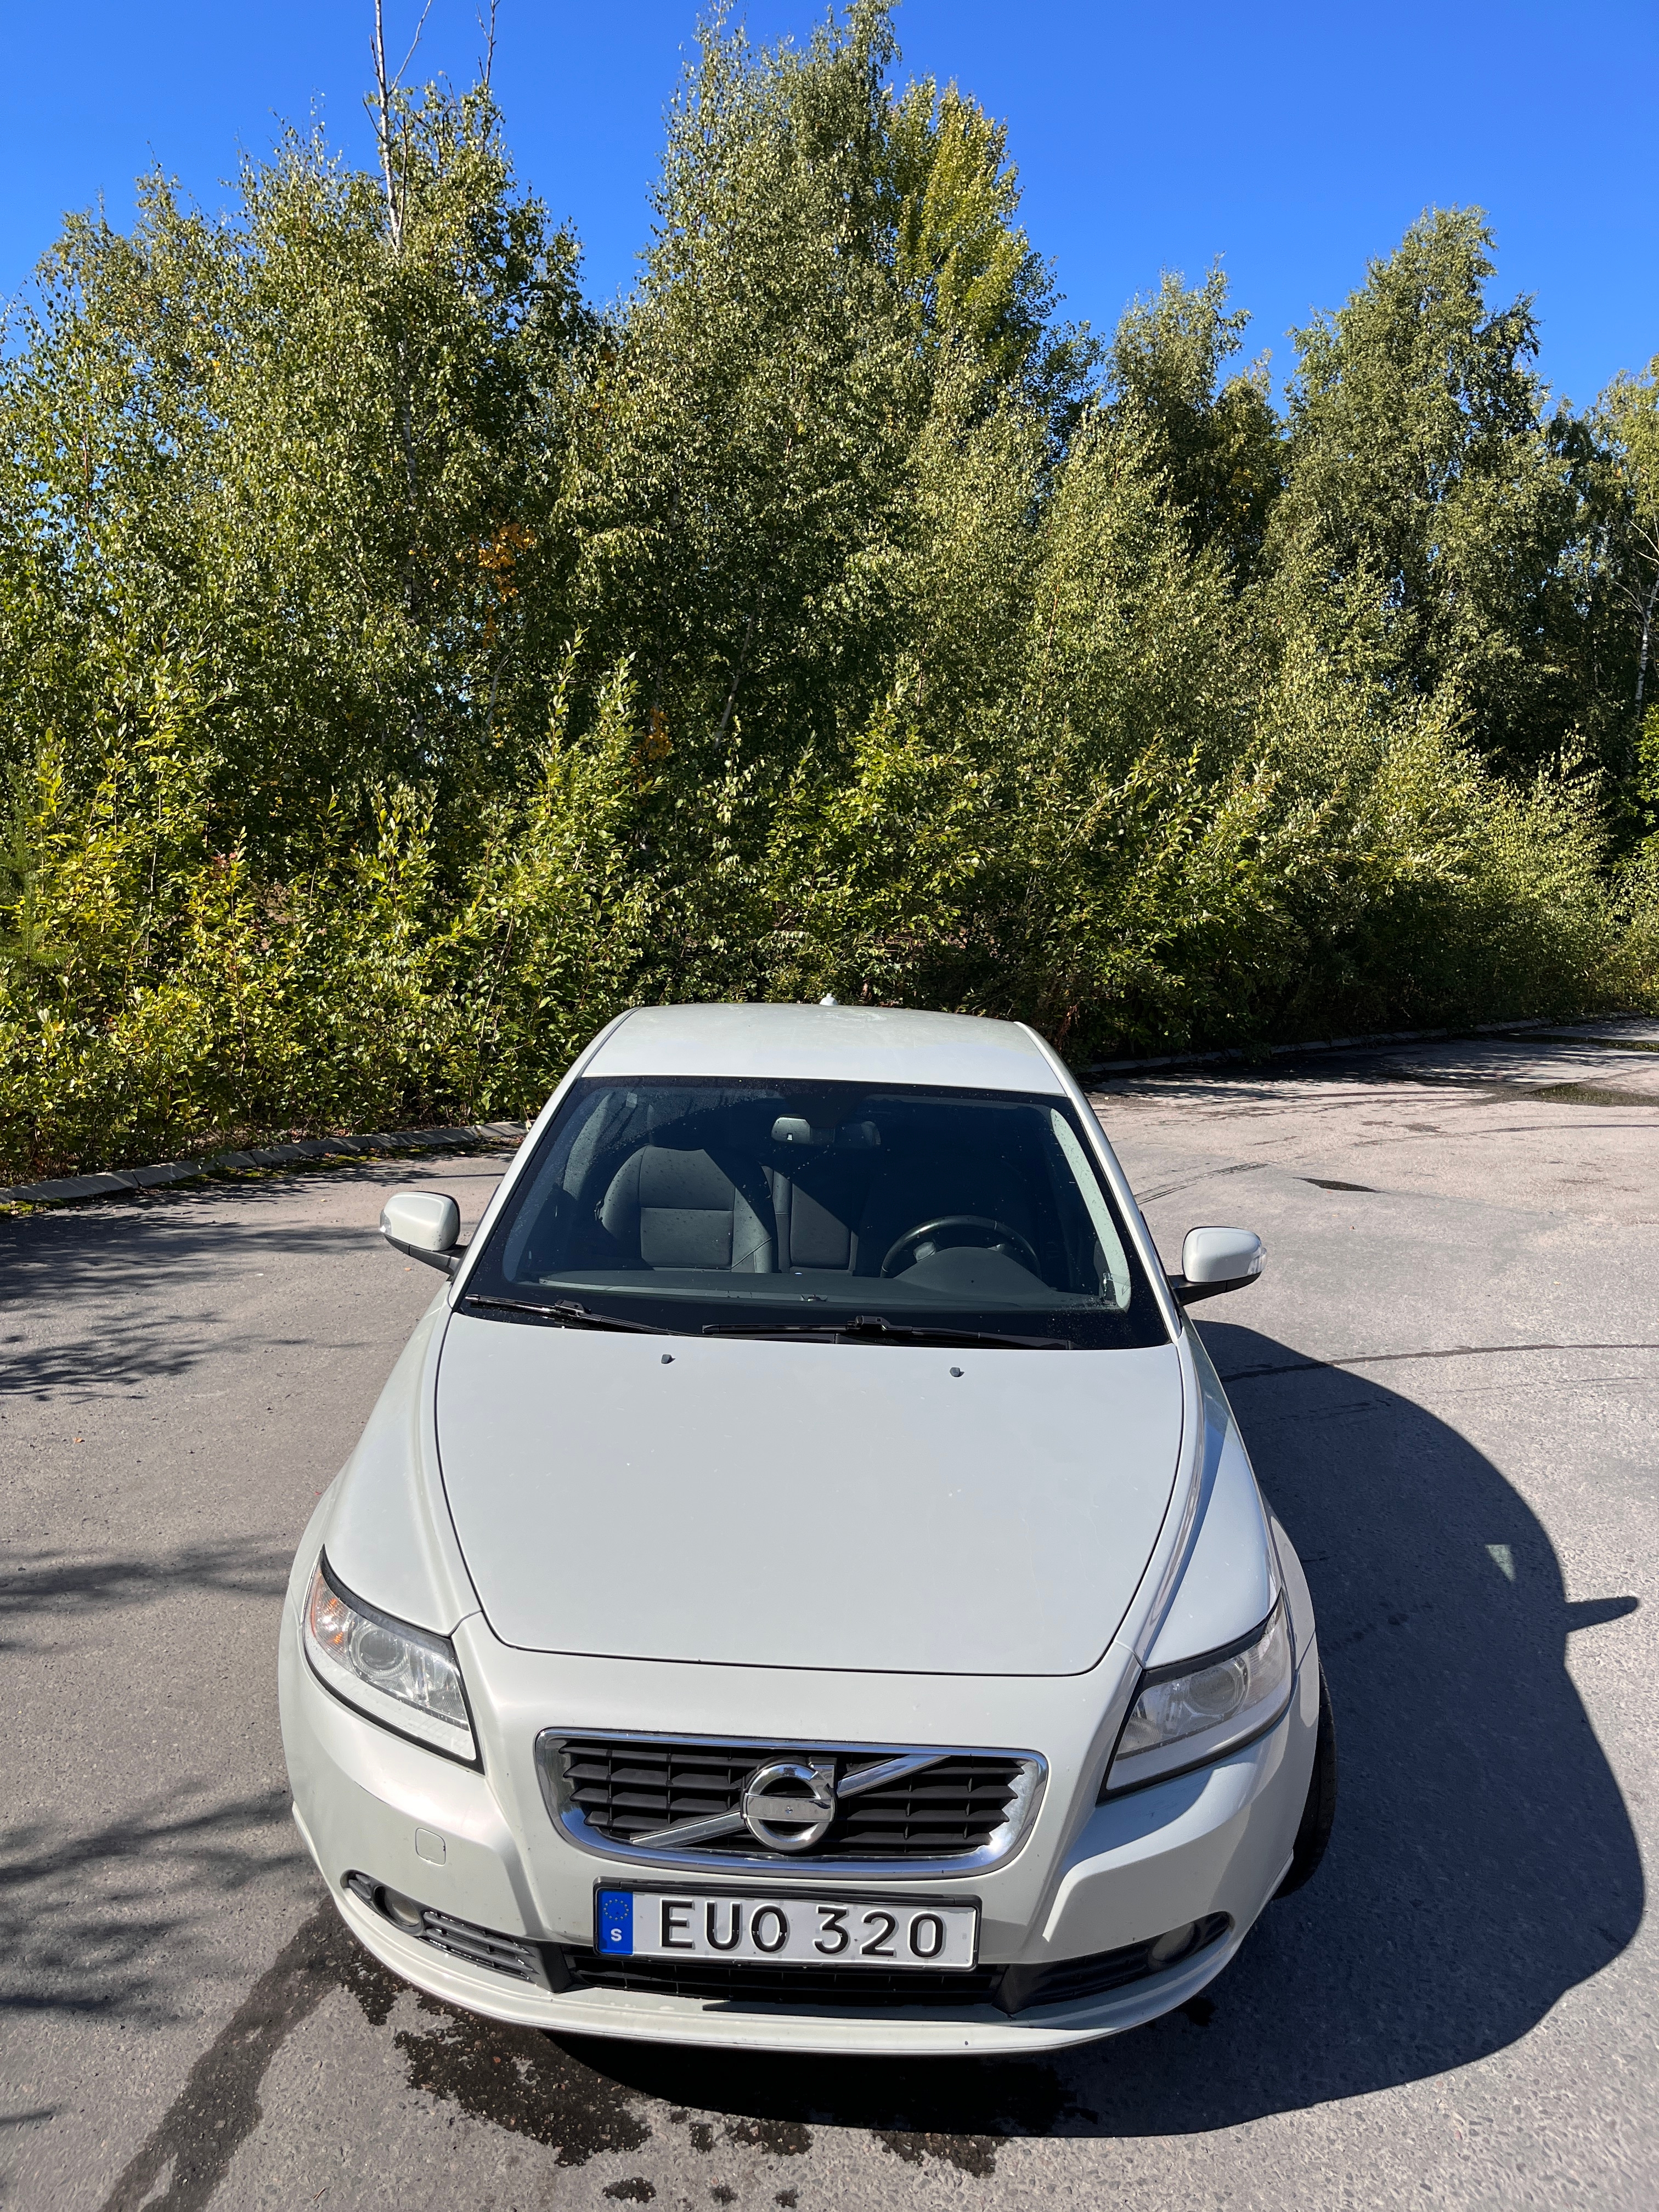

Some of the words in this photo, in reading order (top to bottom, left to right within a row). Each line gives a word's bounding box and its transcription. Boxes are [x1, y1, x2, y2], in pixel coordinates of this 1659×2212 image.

[611, 1928, 622, 1942] S
[661, 1900, 788, 1953] EUO
[814, 1906, 944, 1957] 320
